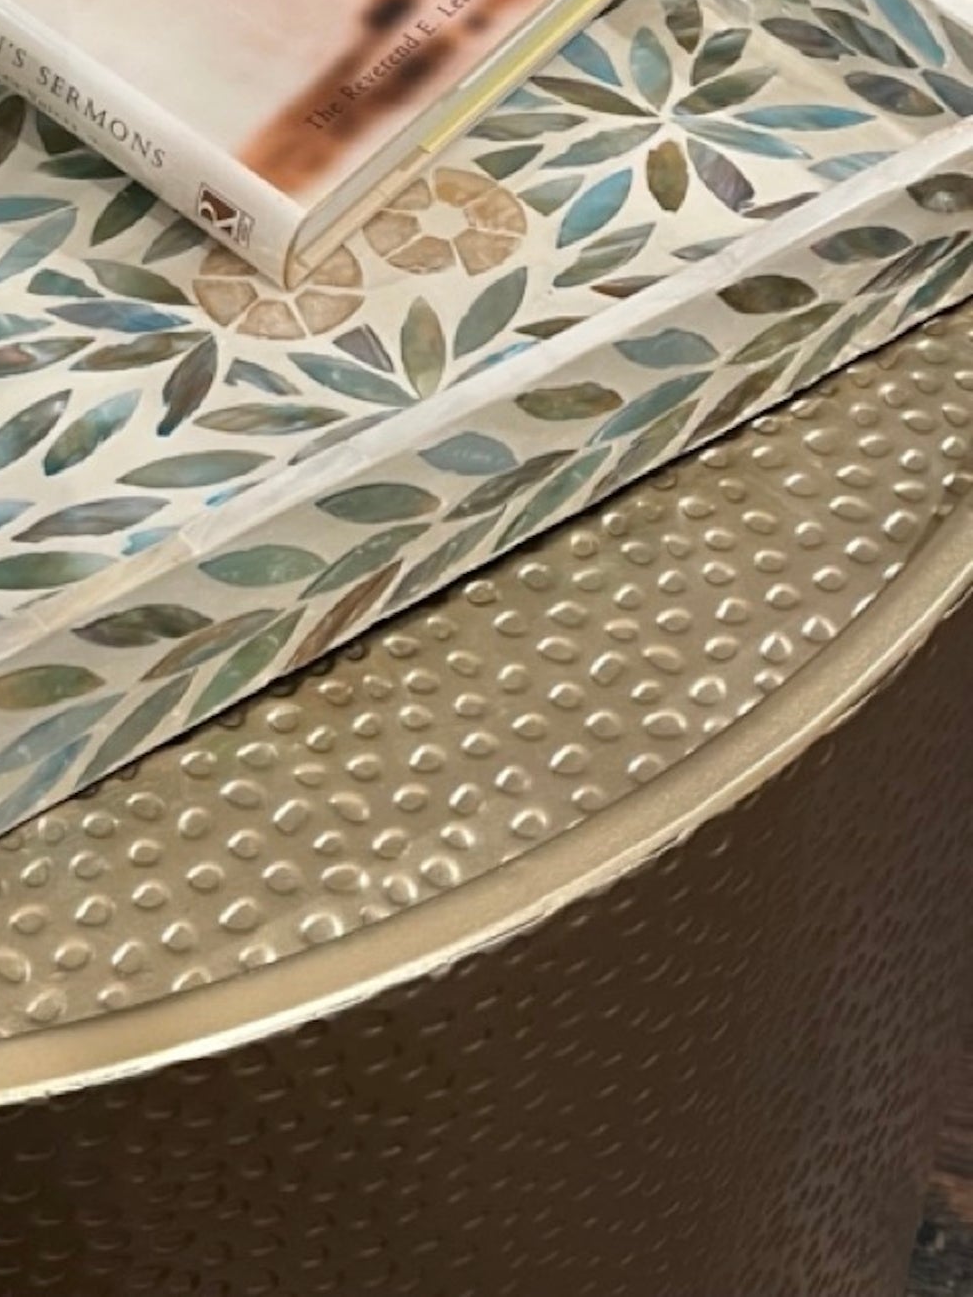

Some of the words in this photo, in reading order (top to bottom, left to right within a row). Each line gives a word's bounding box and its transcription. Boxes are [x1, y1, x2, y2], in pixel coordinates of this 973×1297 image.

[36, 65, 166, 169] SERMONS
[305, 102, 344, 130] The
[340, 34, 420, 100] Reverend
